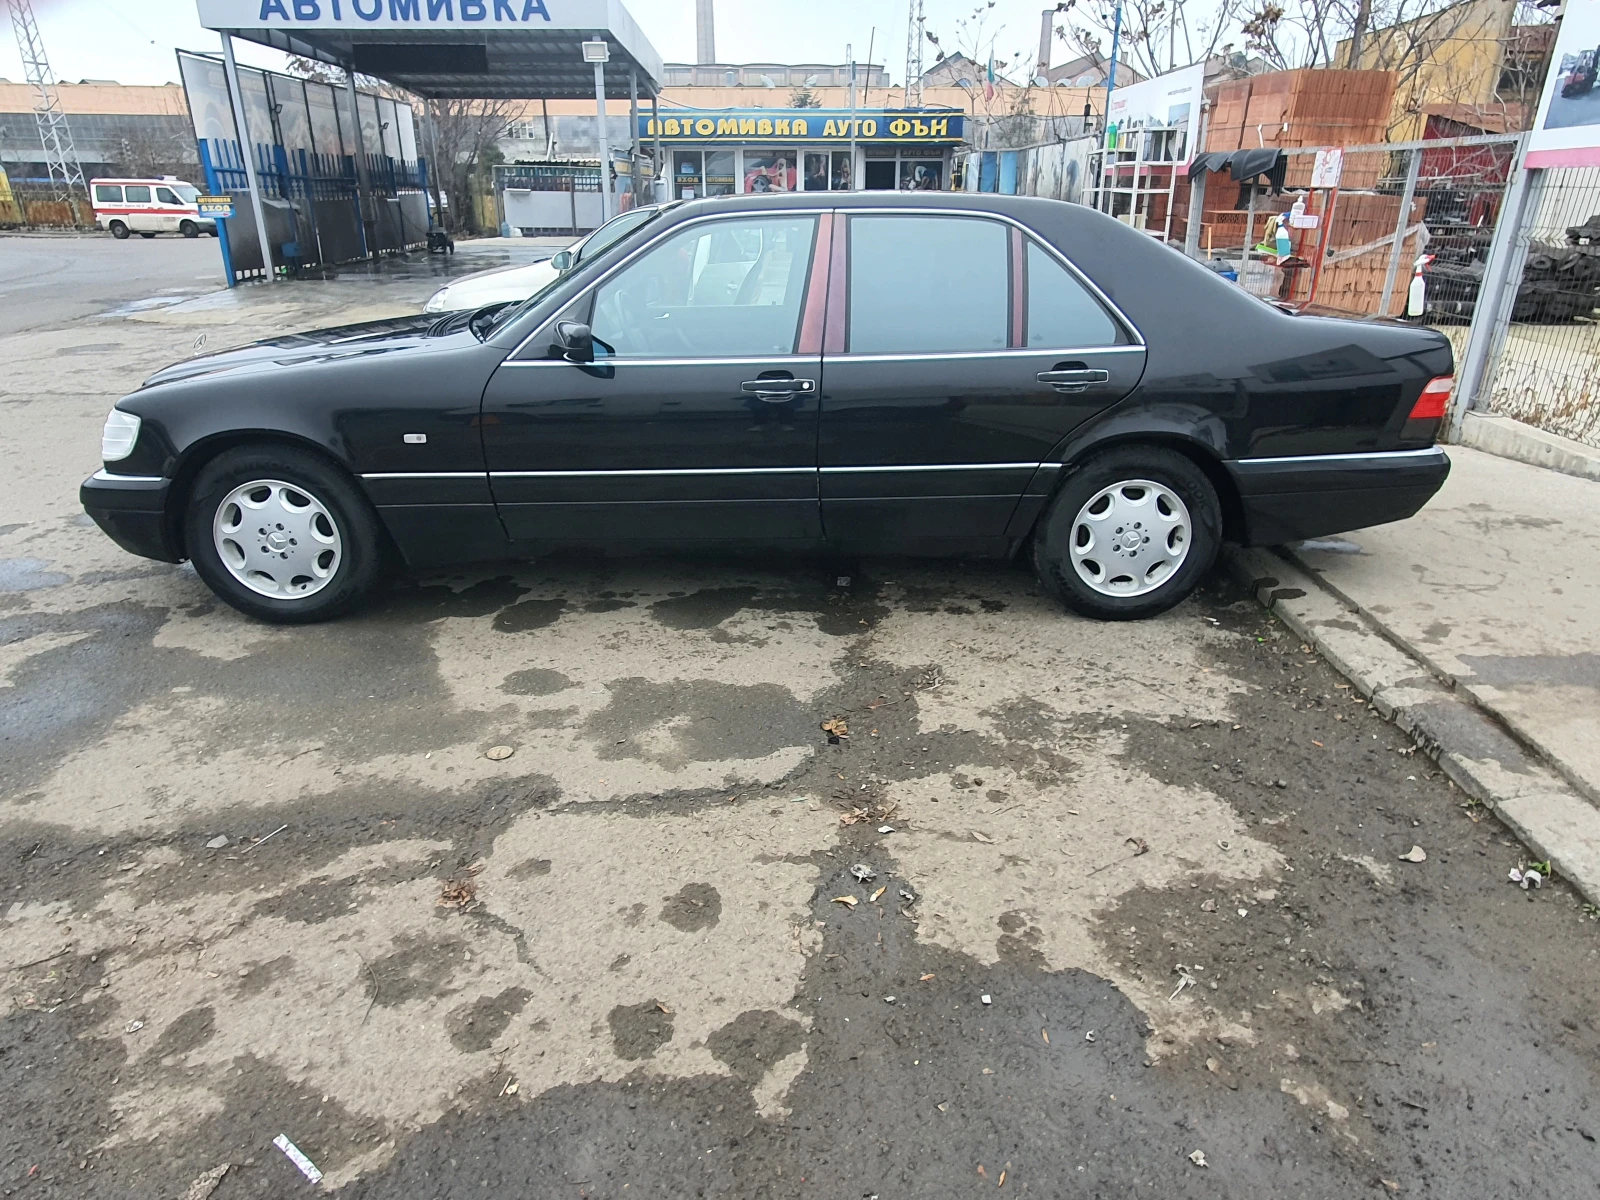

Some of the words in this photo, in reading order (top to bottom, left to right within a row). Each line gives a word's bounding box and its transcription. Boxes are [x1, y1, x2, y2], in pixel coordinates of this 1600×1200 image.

[259, 0, 552, 22] АВТОМИВКА
[647, 118, 808, 136] АВТОМИВКА
[822, 118, 877, 137] АУТО
[889, 118, 948, 137] ФЪН
